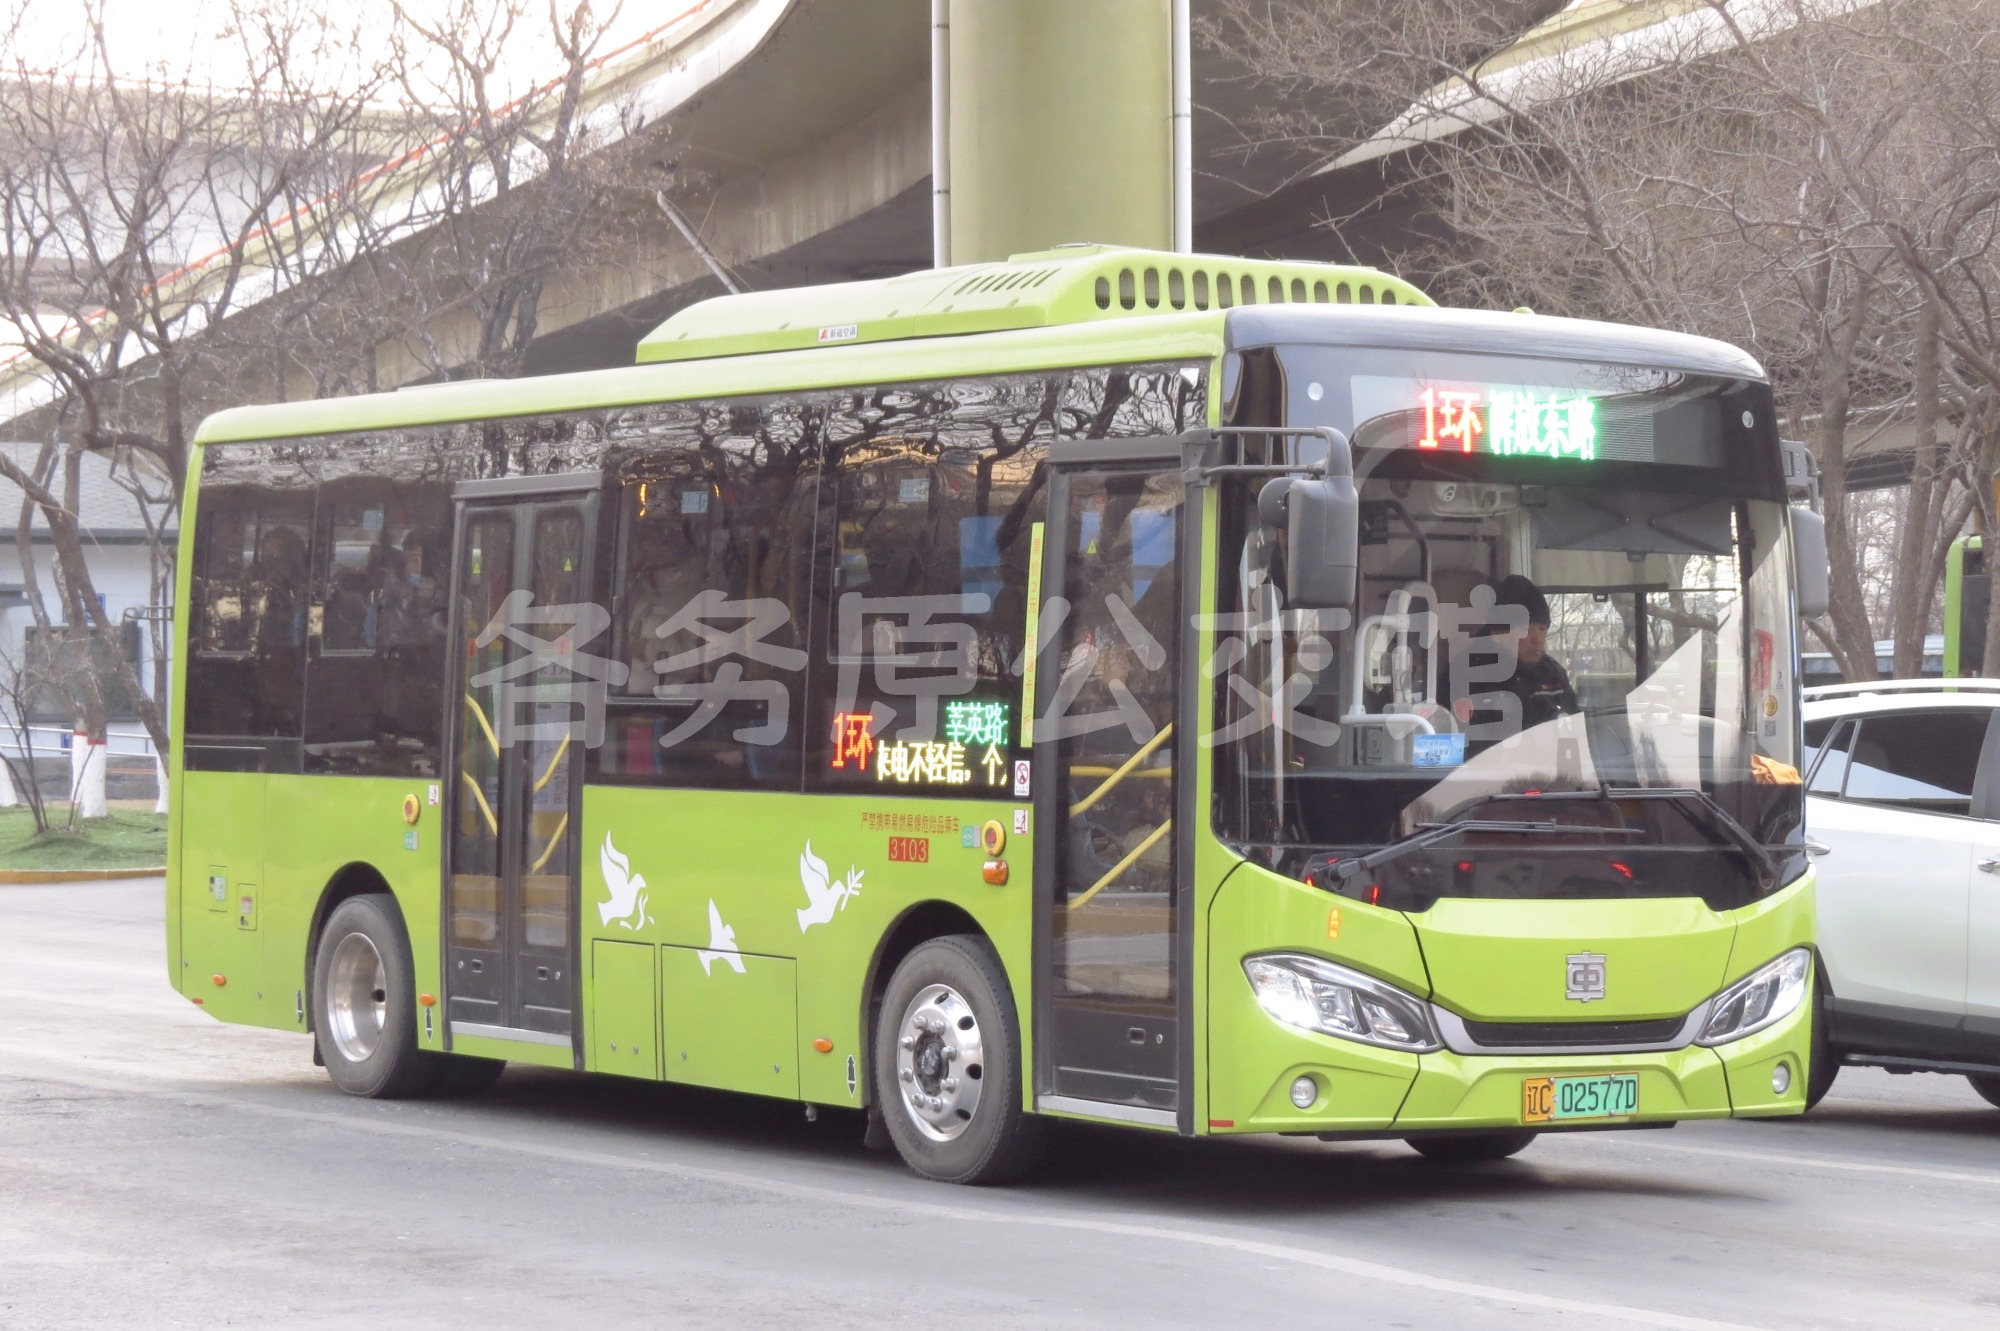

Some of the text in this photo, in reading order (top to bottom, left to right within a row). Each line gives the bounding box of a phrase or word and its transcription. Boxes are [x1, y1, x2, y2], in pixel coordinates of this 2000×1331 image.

[1418, 387, 1483, 453] 1环
[832, 711, 874, 771] 1环
[945, 701, 1010, 745] 莘英路
[889, 837, 928, 862] 3103
